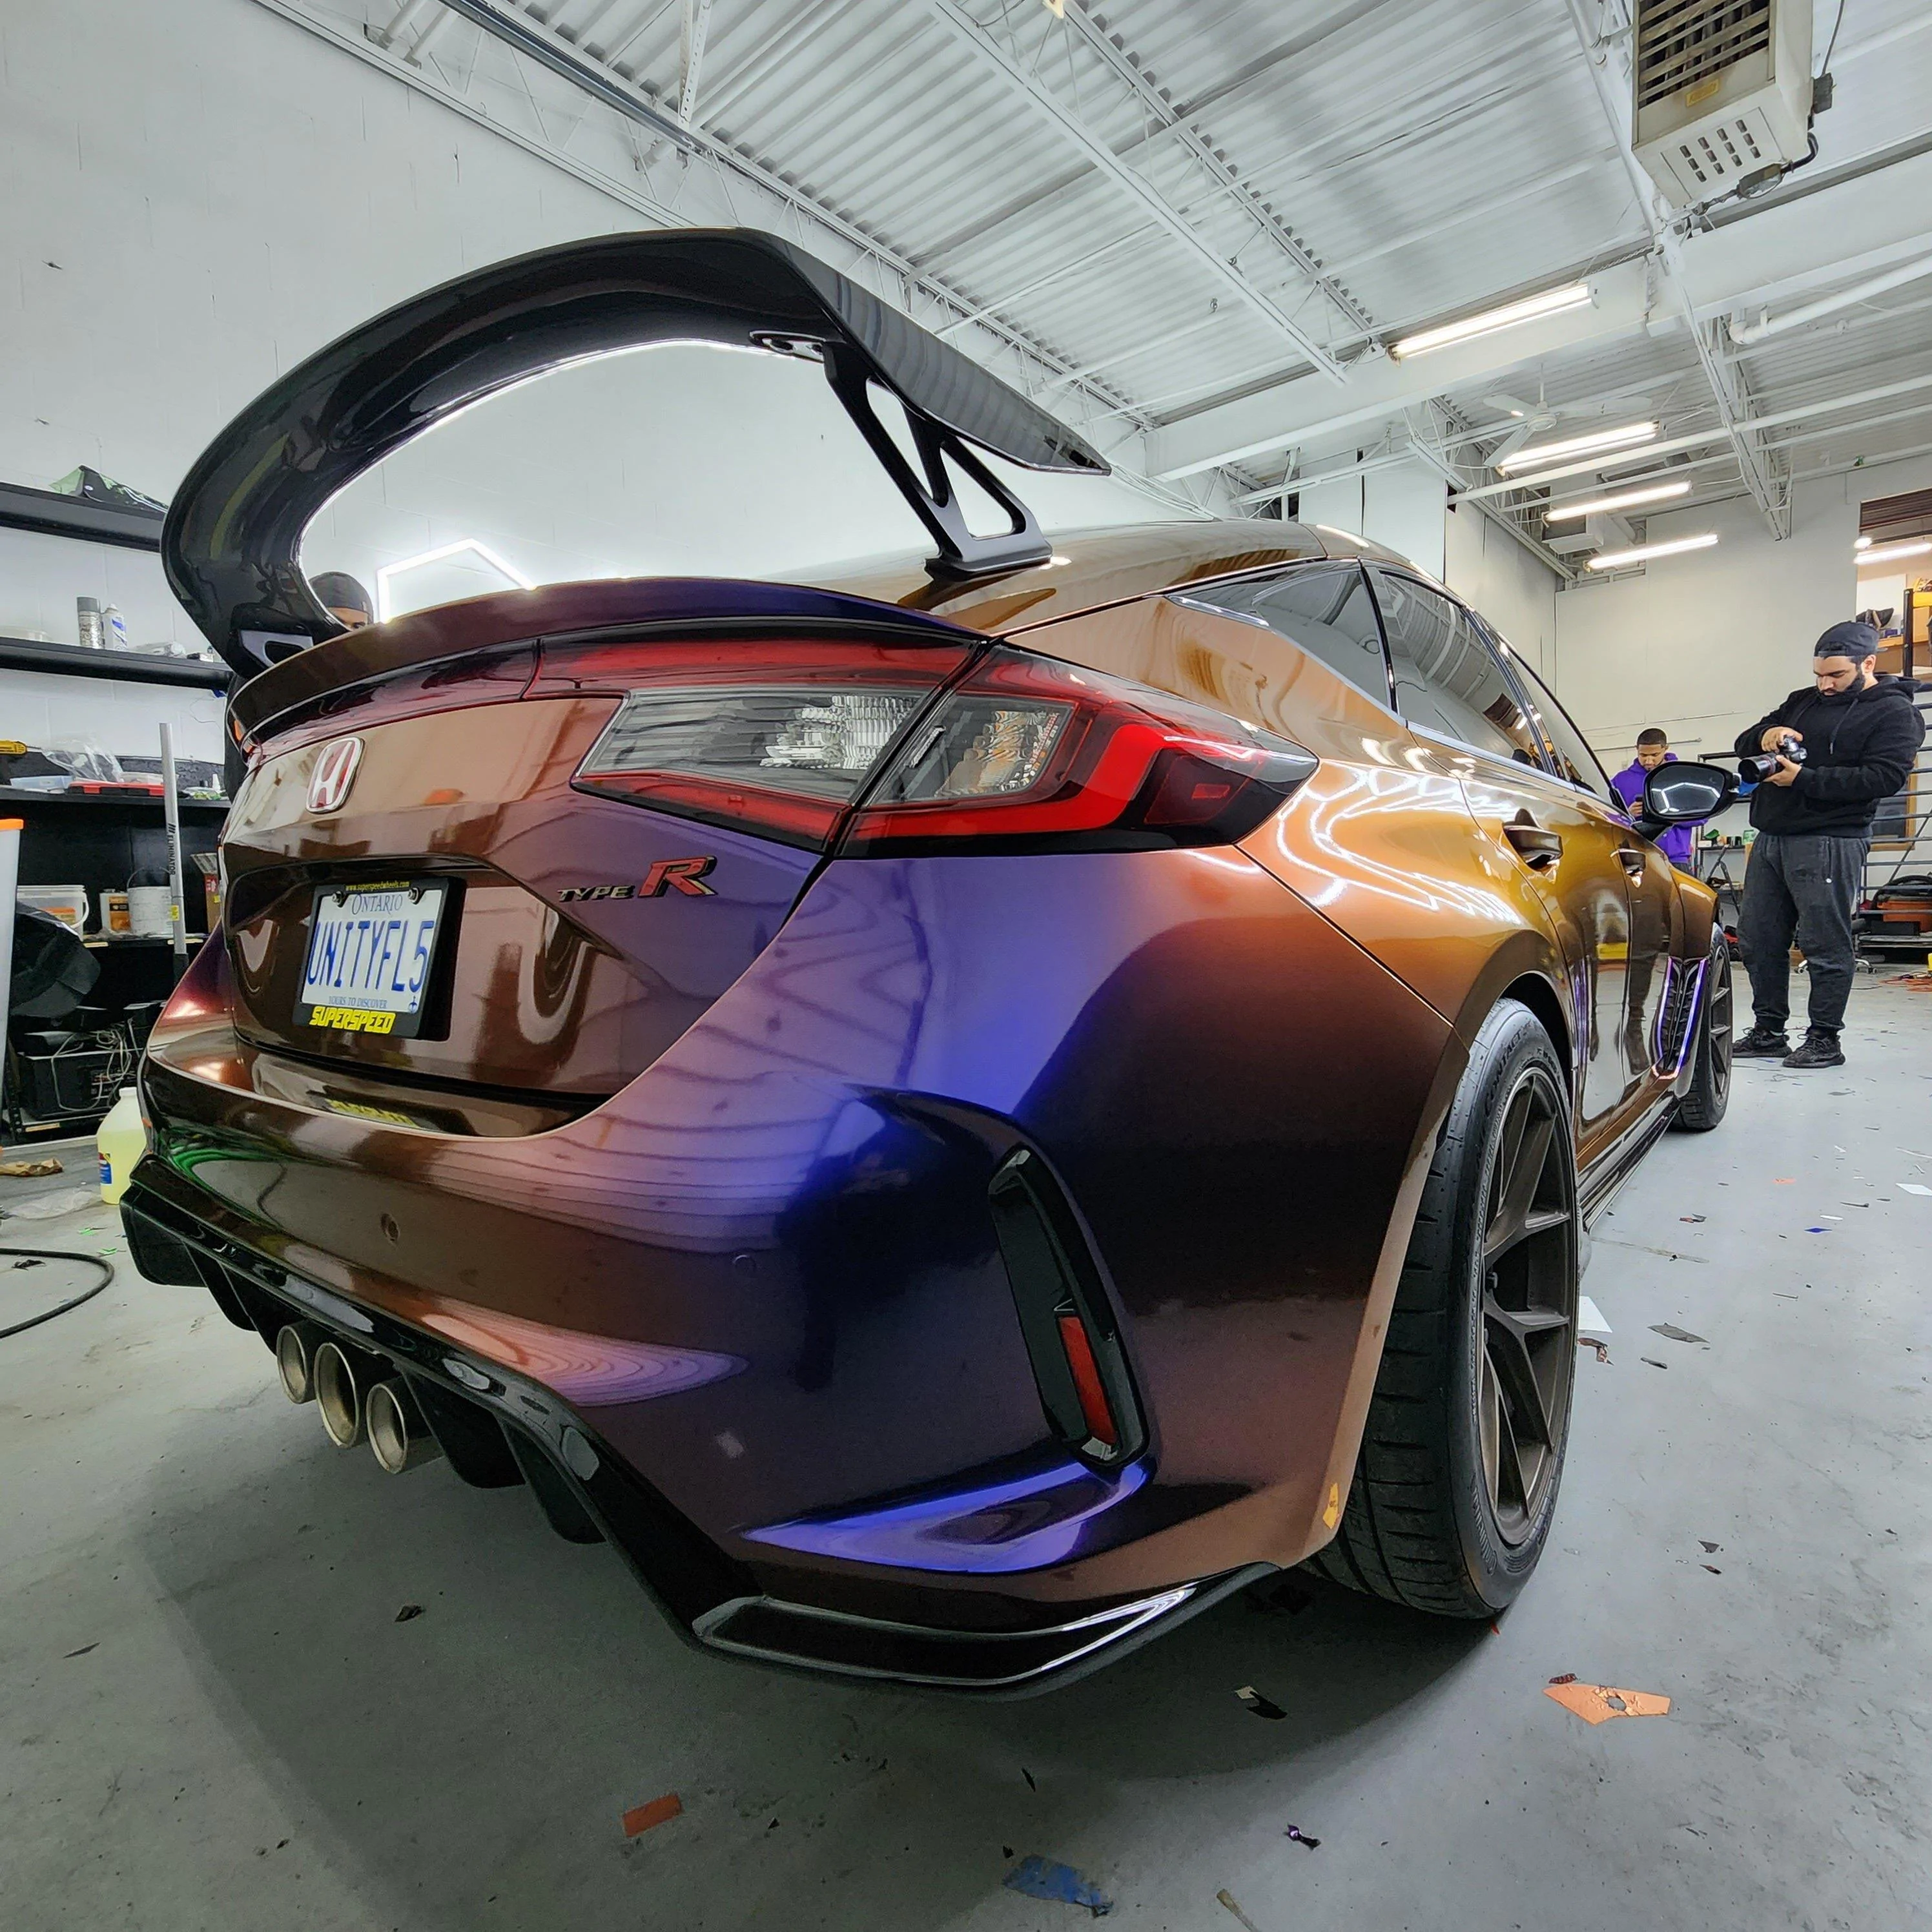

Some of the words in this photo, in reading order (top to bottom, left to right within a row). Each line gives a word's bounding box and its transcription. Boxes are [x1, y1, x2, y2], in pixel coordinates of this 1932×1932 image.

[167, 834, 176, 876] ELIMINATOR
[557, 885, 635, 903] TYPE
[637, 855, 718, 898] R
[307, 920, 435, 993] UNITYFL5
[309, 1005, 396, 1034] SUPERSPEED
[328, 996, 346, 1005] YOURS
[349, 997, 356, 1007] TO
[356, 998, 387, 1009] DISCOVER
